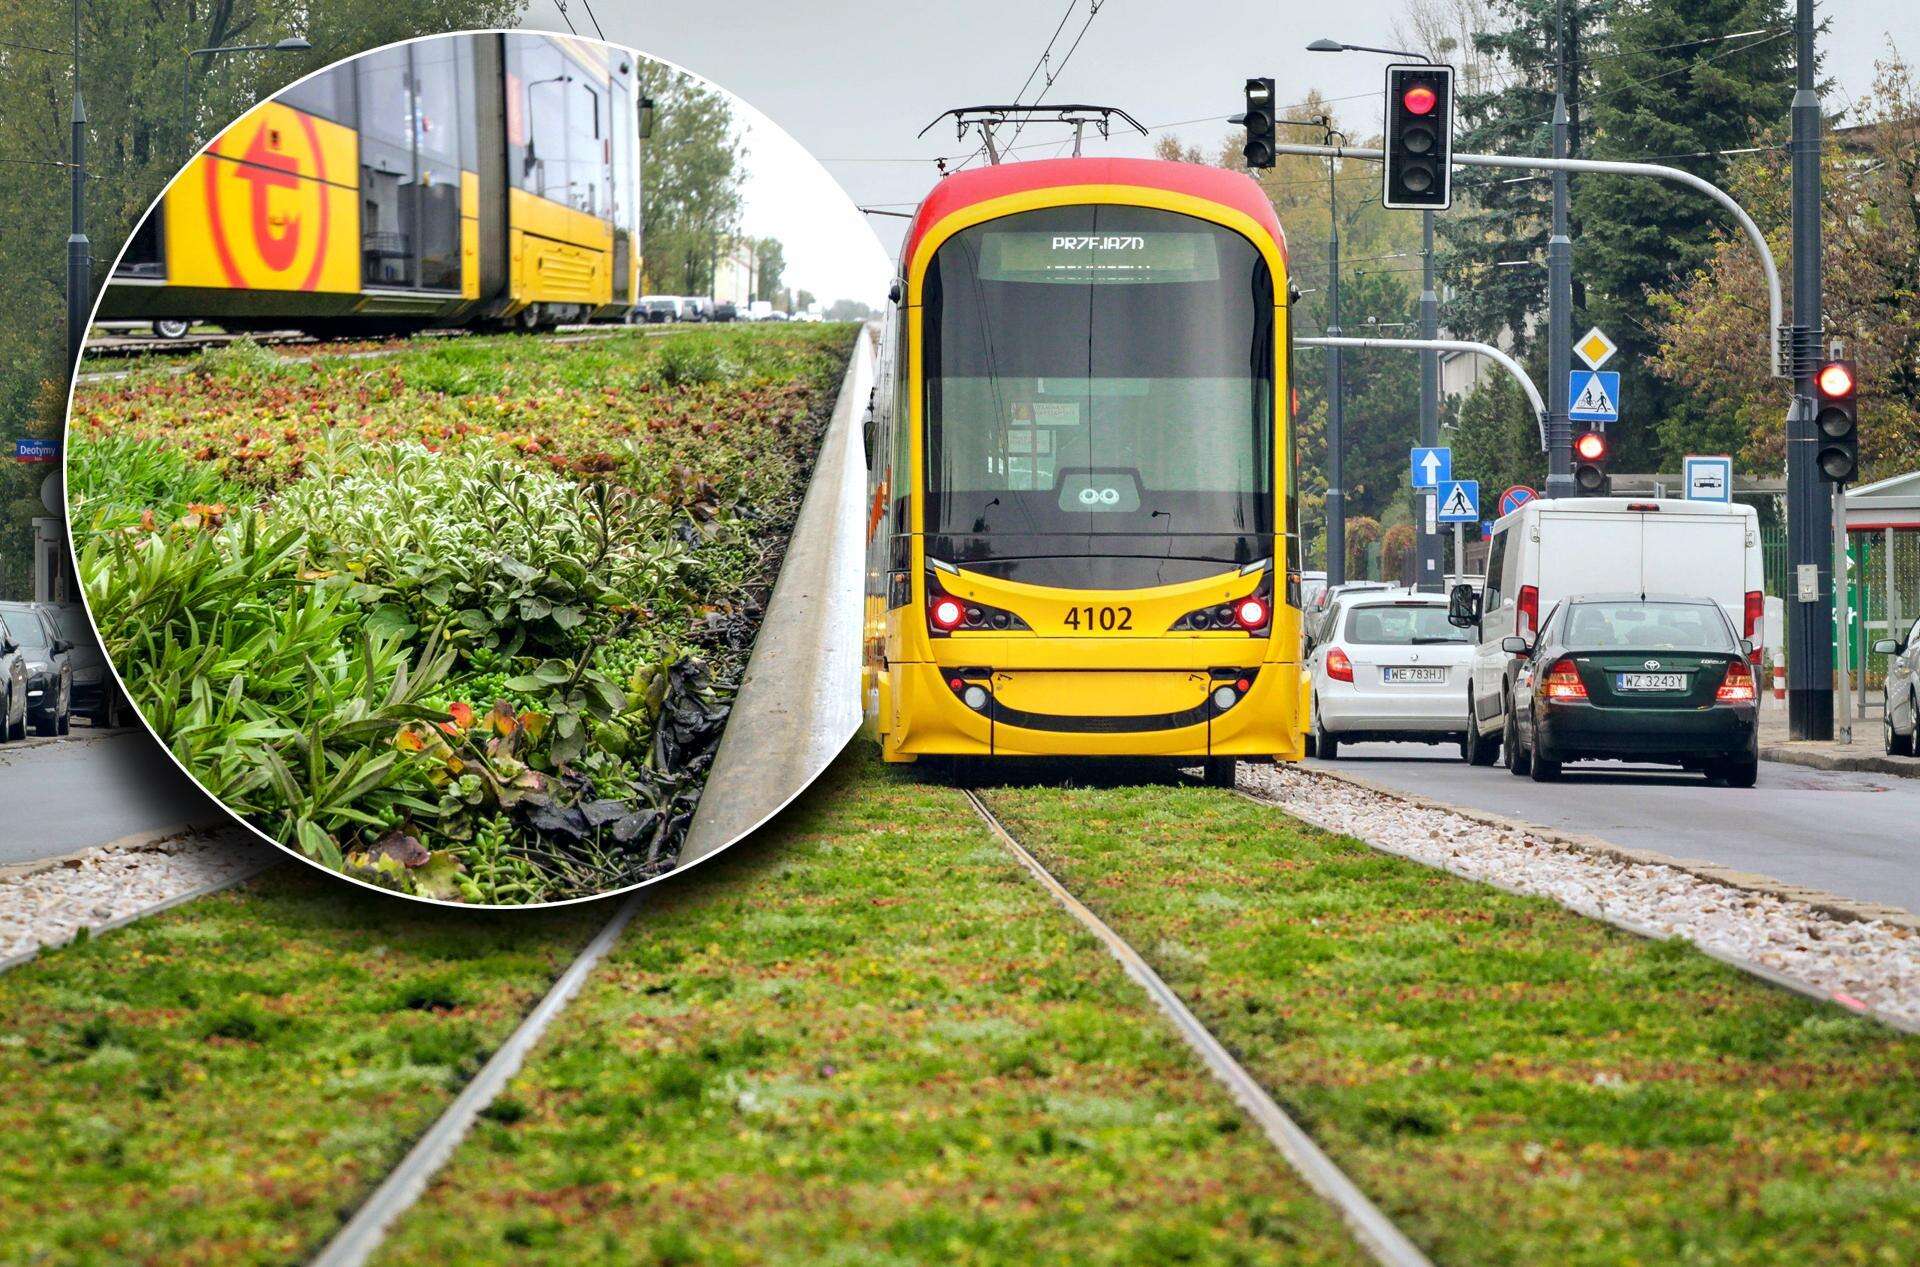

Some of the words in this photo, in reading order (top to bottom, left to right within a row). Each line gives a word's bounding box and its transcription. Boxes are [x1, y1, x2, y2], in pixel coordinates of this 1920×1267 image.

[20, 445, 56, 456] Deotymy
[1063, 606, 1132, 631] 4102
[1392, 669, 1407, 680] WE
[1410, 669, 1442, 680] 783HJ
[1626, 675, 1641, 687] WZ
[1646, 675, 1683, 687] 3243Y
